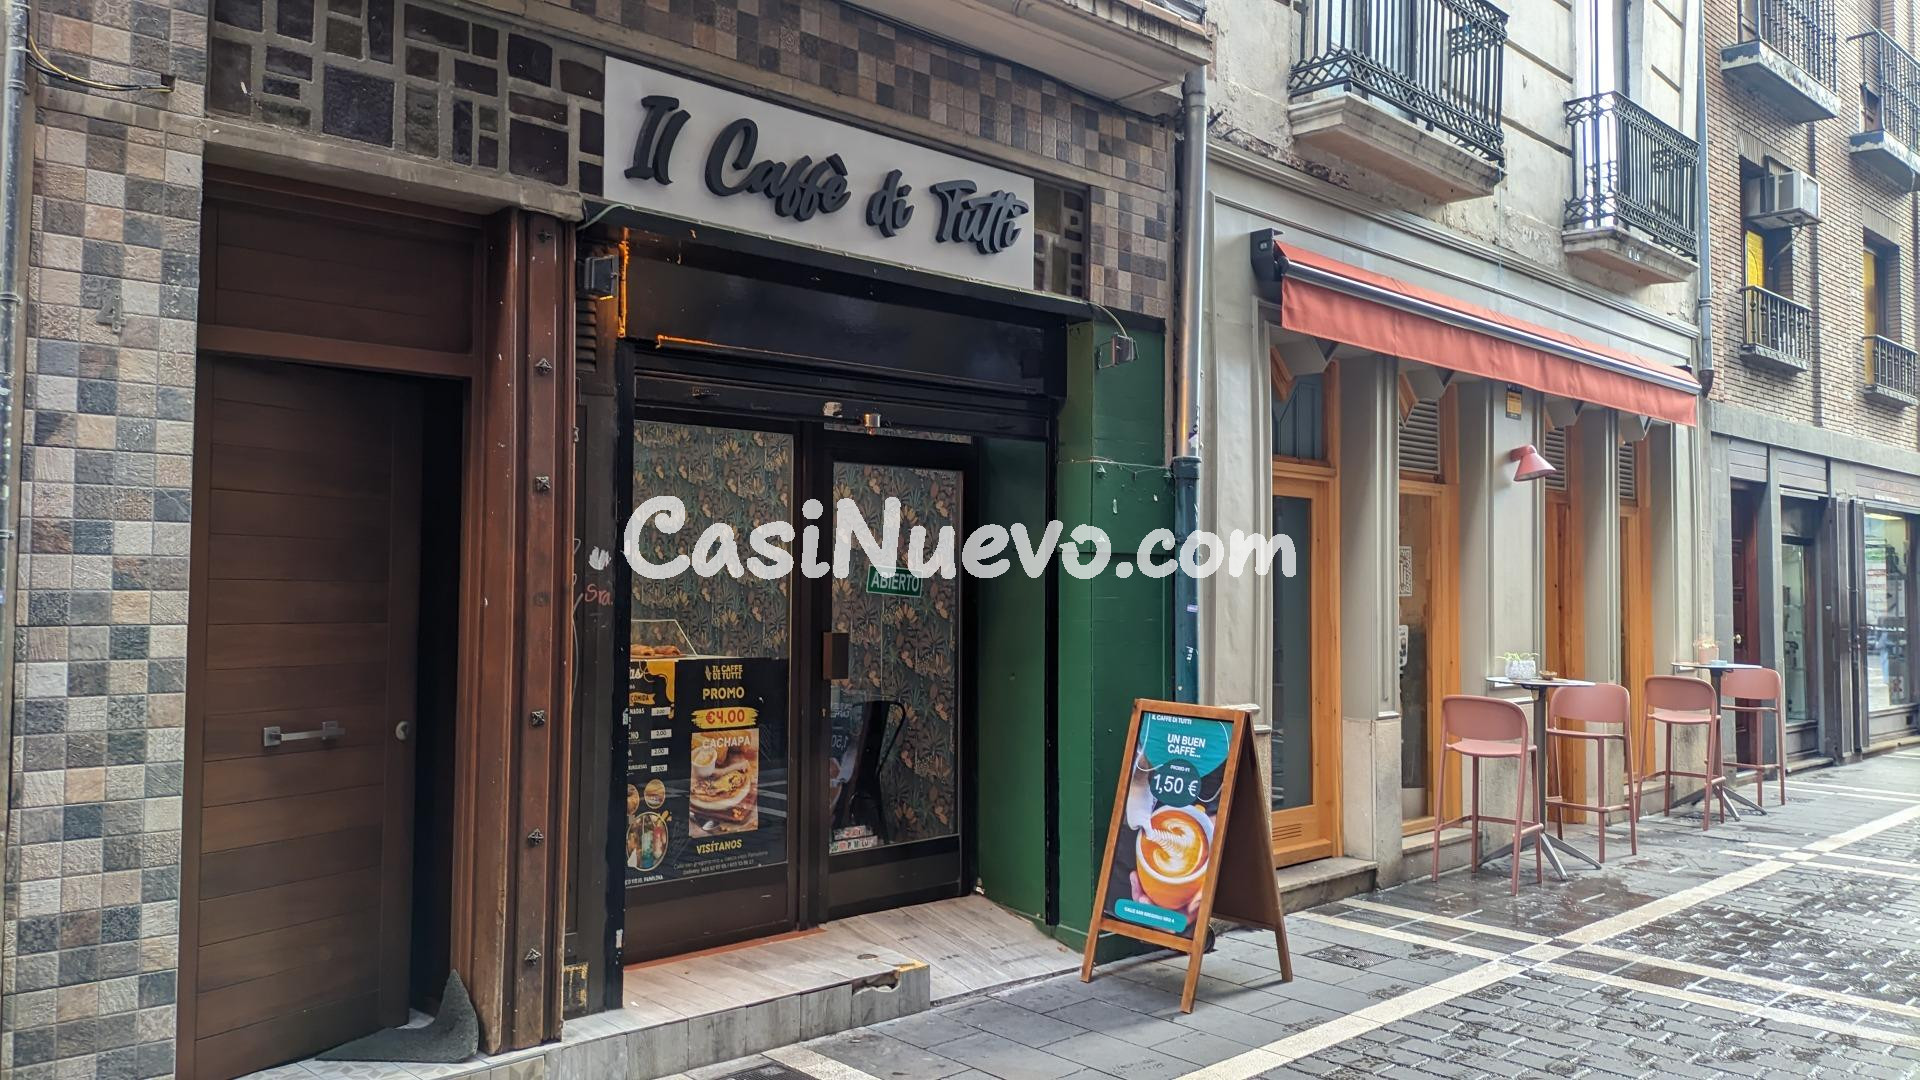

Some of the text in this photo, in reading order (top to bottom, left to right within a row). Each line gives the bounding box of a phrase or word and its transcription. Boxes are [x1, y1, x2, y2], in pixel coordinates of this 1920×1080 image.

[624, 95, 1029, 255] Il Caffè di Tutti
[871, 571, 920, 593] ABIERTO
[722, 671, 743, 680] TUTTI
[702, 686, 745, 700] PROMO
[702, 735, 751, 749] CACHAPA
[1167, 733, 1206, 748] UN BUEN
[1153, 773, 1199, 797] 1,50 €
[696, 838, 743, 855] VISÍTANOS
